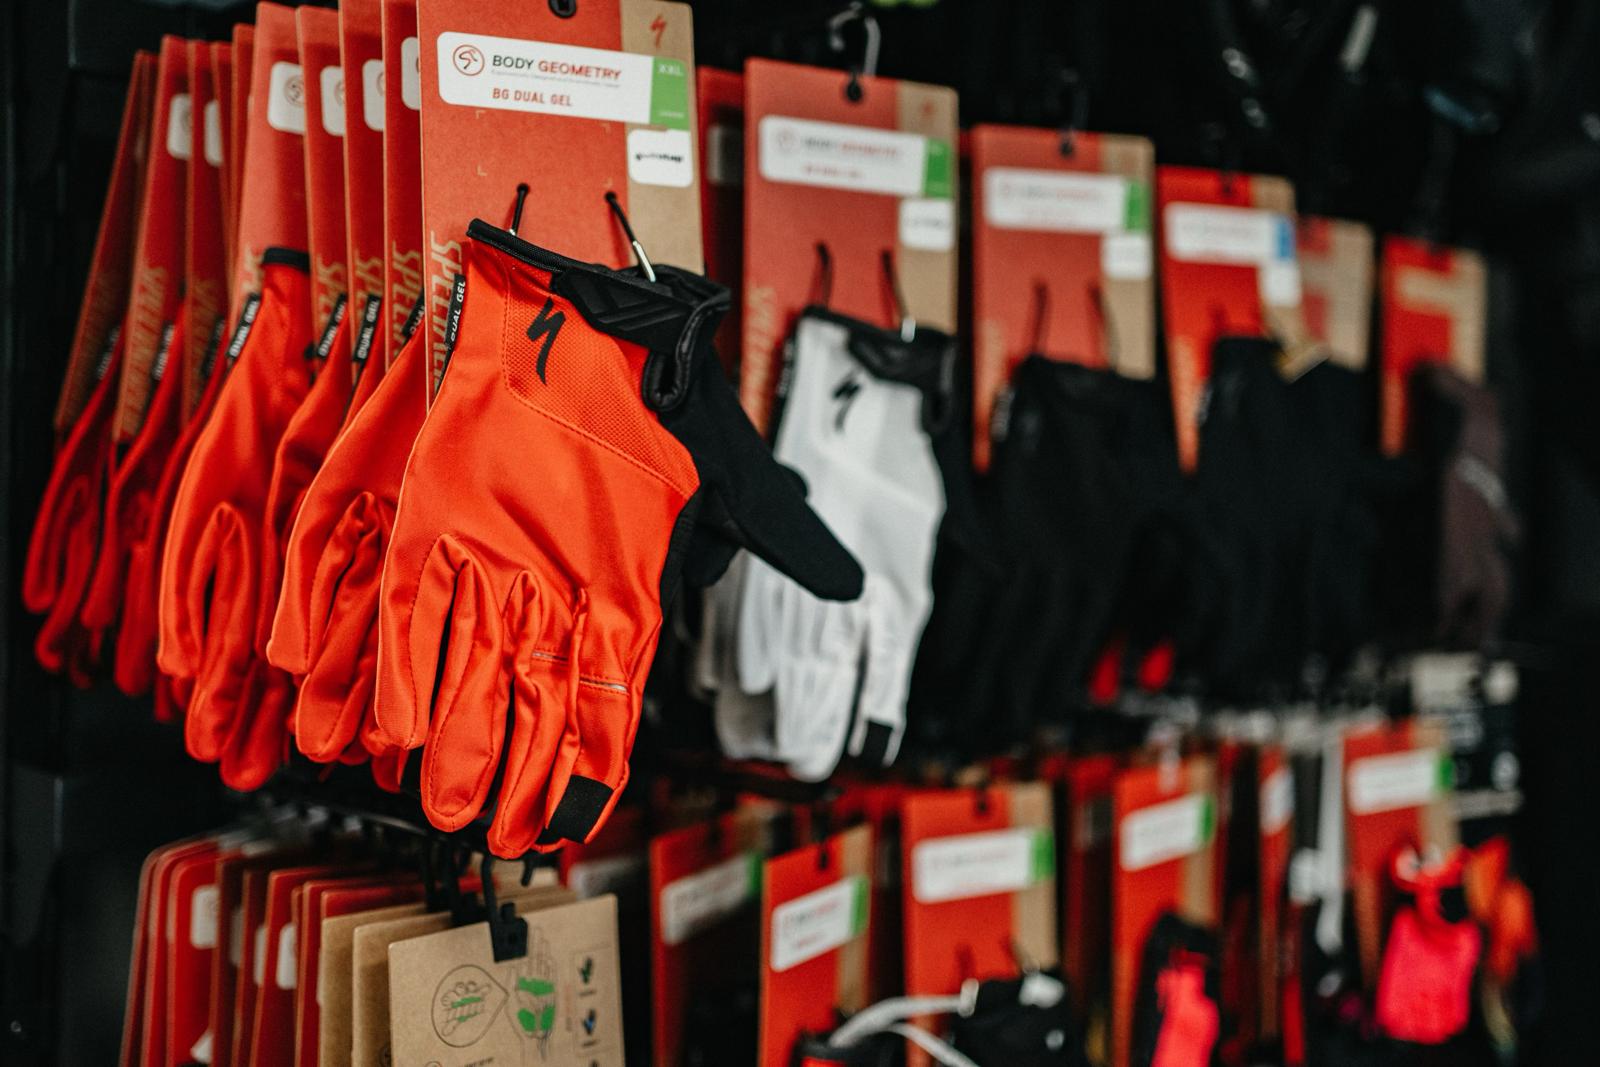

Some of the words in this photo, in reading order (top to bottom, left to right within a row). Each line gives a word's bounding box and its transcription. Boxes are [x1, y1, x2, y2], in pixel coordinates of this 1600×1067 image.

[492, 55, 534, 70] BODY
[538, 60, 622, 80] GEOMETRY
[492, 87, 510, 100] BG
[514, 90, 545, 104] DUAL
[550, 94, 573, 107] GEL
[450, 308, 462, 342] DUAL
[456, 281, 466, 303] GEL
